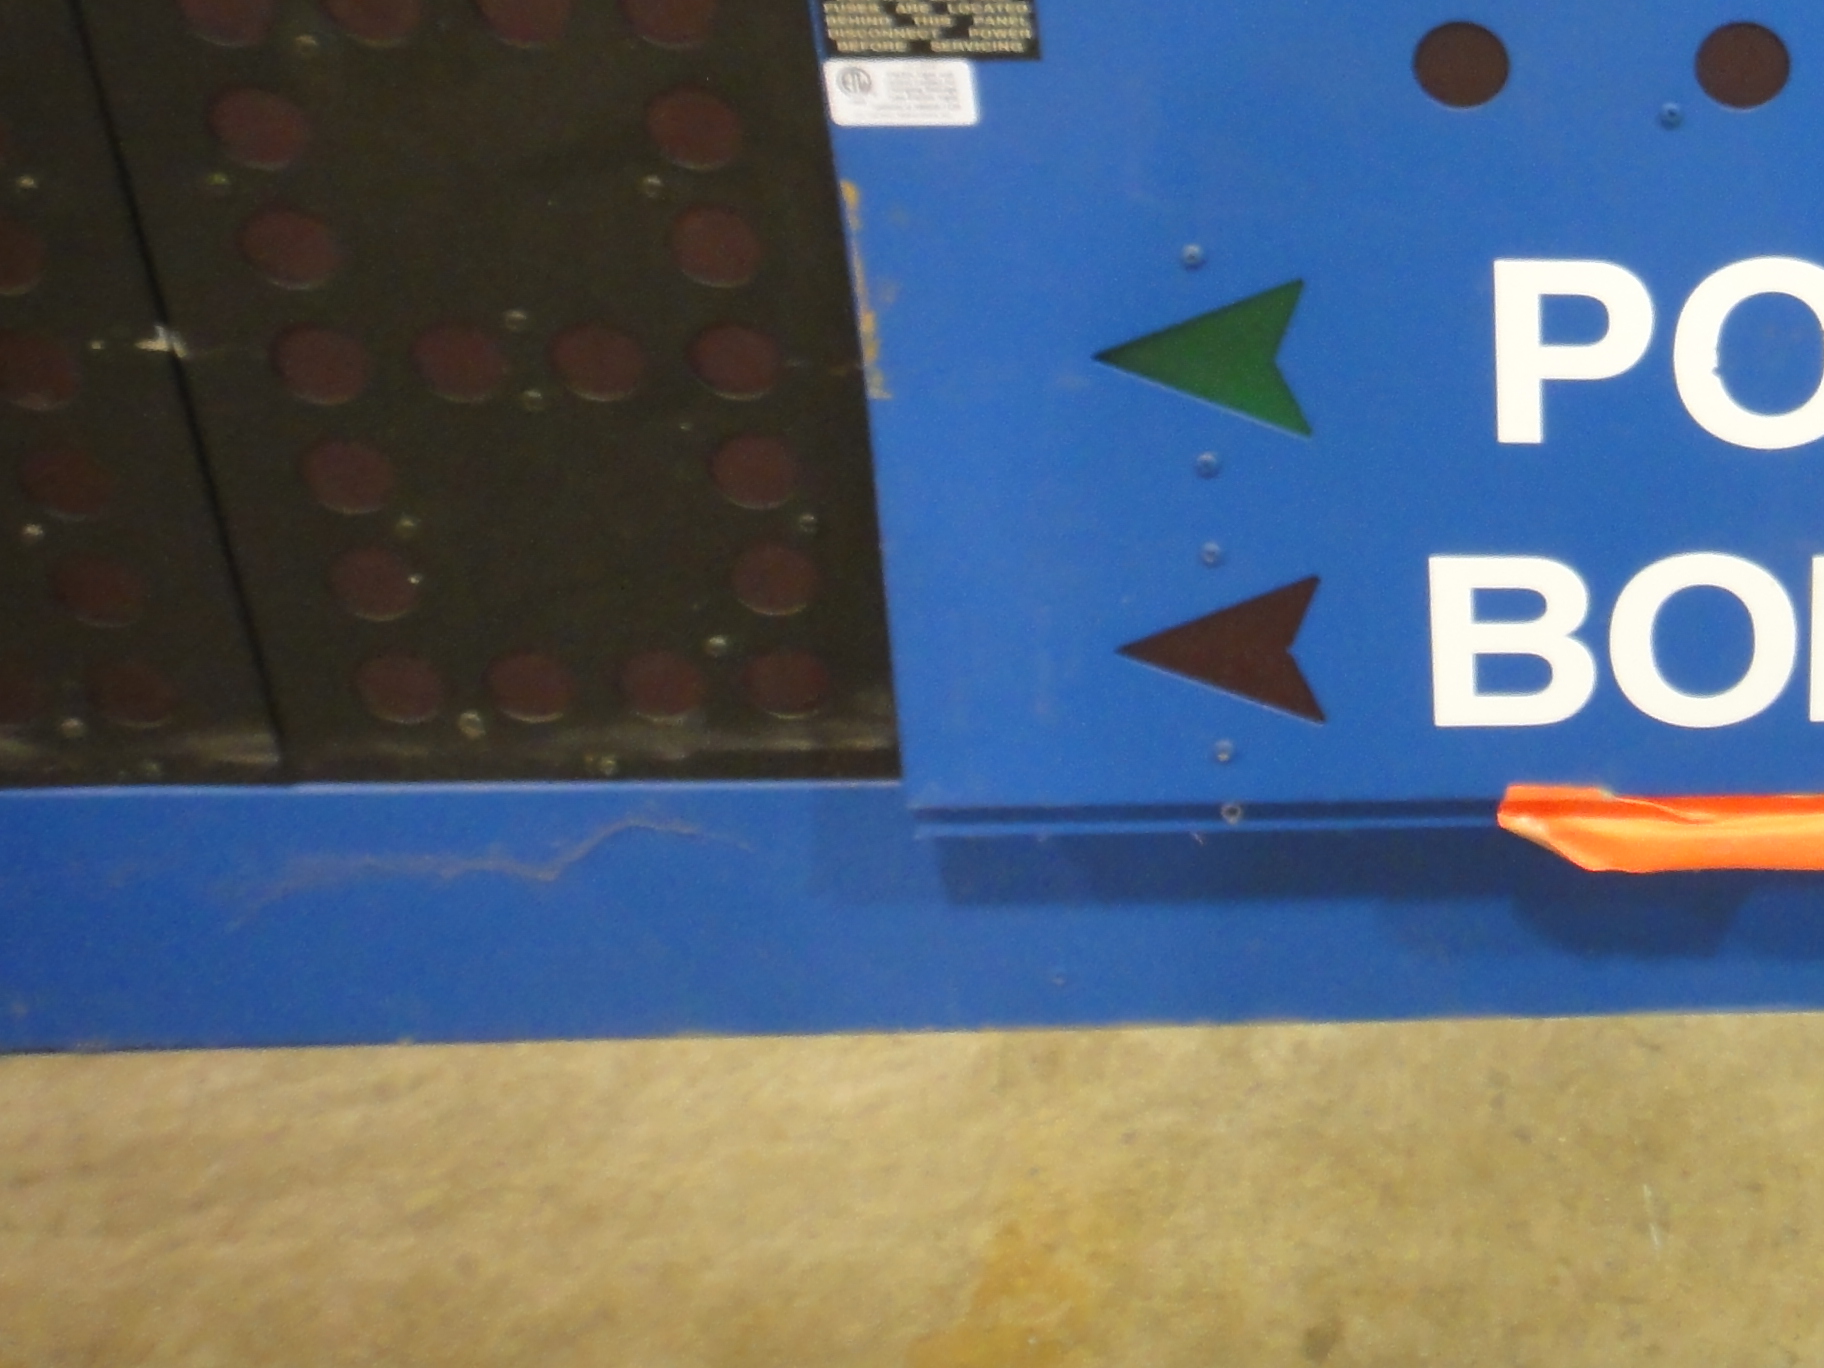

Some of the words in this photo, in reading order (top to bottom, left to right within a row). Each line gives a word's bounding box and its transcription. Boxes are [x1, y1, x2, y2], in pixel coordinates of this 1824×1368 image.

[895, 3, 930, 14] ARE
[947, 2, 1029, 14] LOCATED
[826, 14, 890, 25] BEHIND
[828, 27, 939, 39] DISCONNECT
[968, 27, 1031, 39] POWER
[837, 40, 907, 52] BEFORE
[930, 40, 1024, 52] SERVICING
